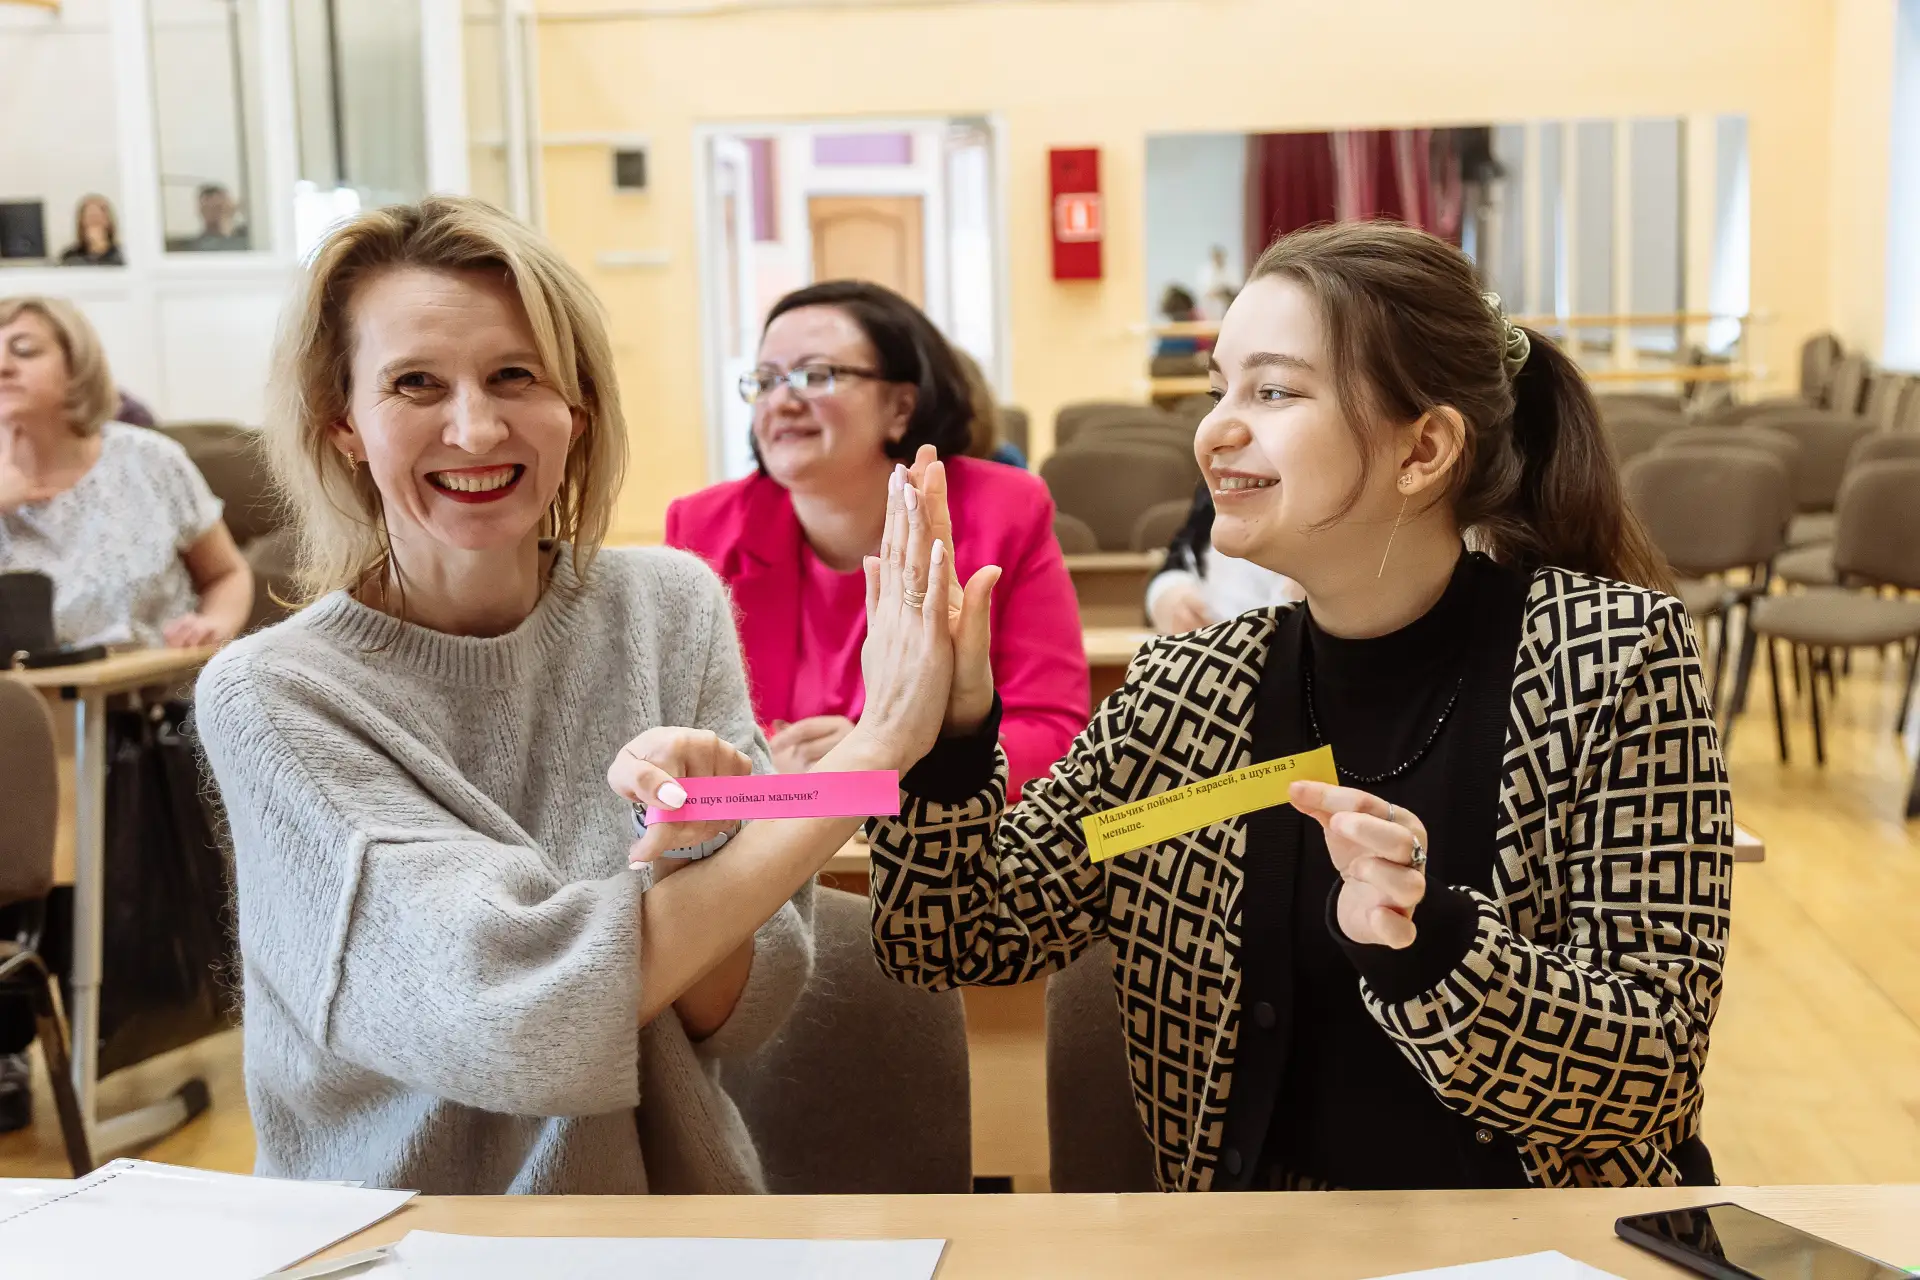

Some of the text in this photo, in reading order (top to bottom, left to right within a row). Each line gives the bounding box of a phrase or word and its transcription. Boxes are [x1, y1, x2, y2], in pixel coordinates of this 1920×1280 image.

[700, 795, 723, 806] щук
[725, 792, 765, 803] поймал
[768, 789, 819, 802] мальчик?
[1098, 758, 1296, 826] Мальчик поймал 5 карасей, а щук на 3
[1102, 821, 1145, 841] меньше.
